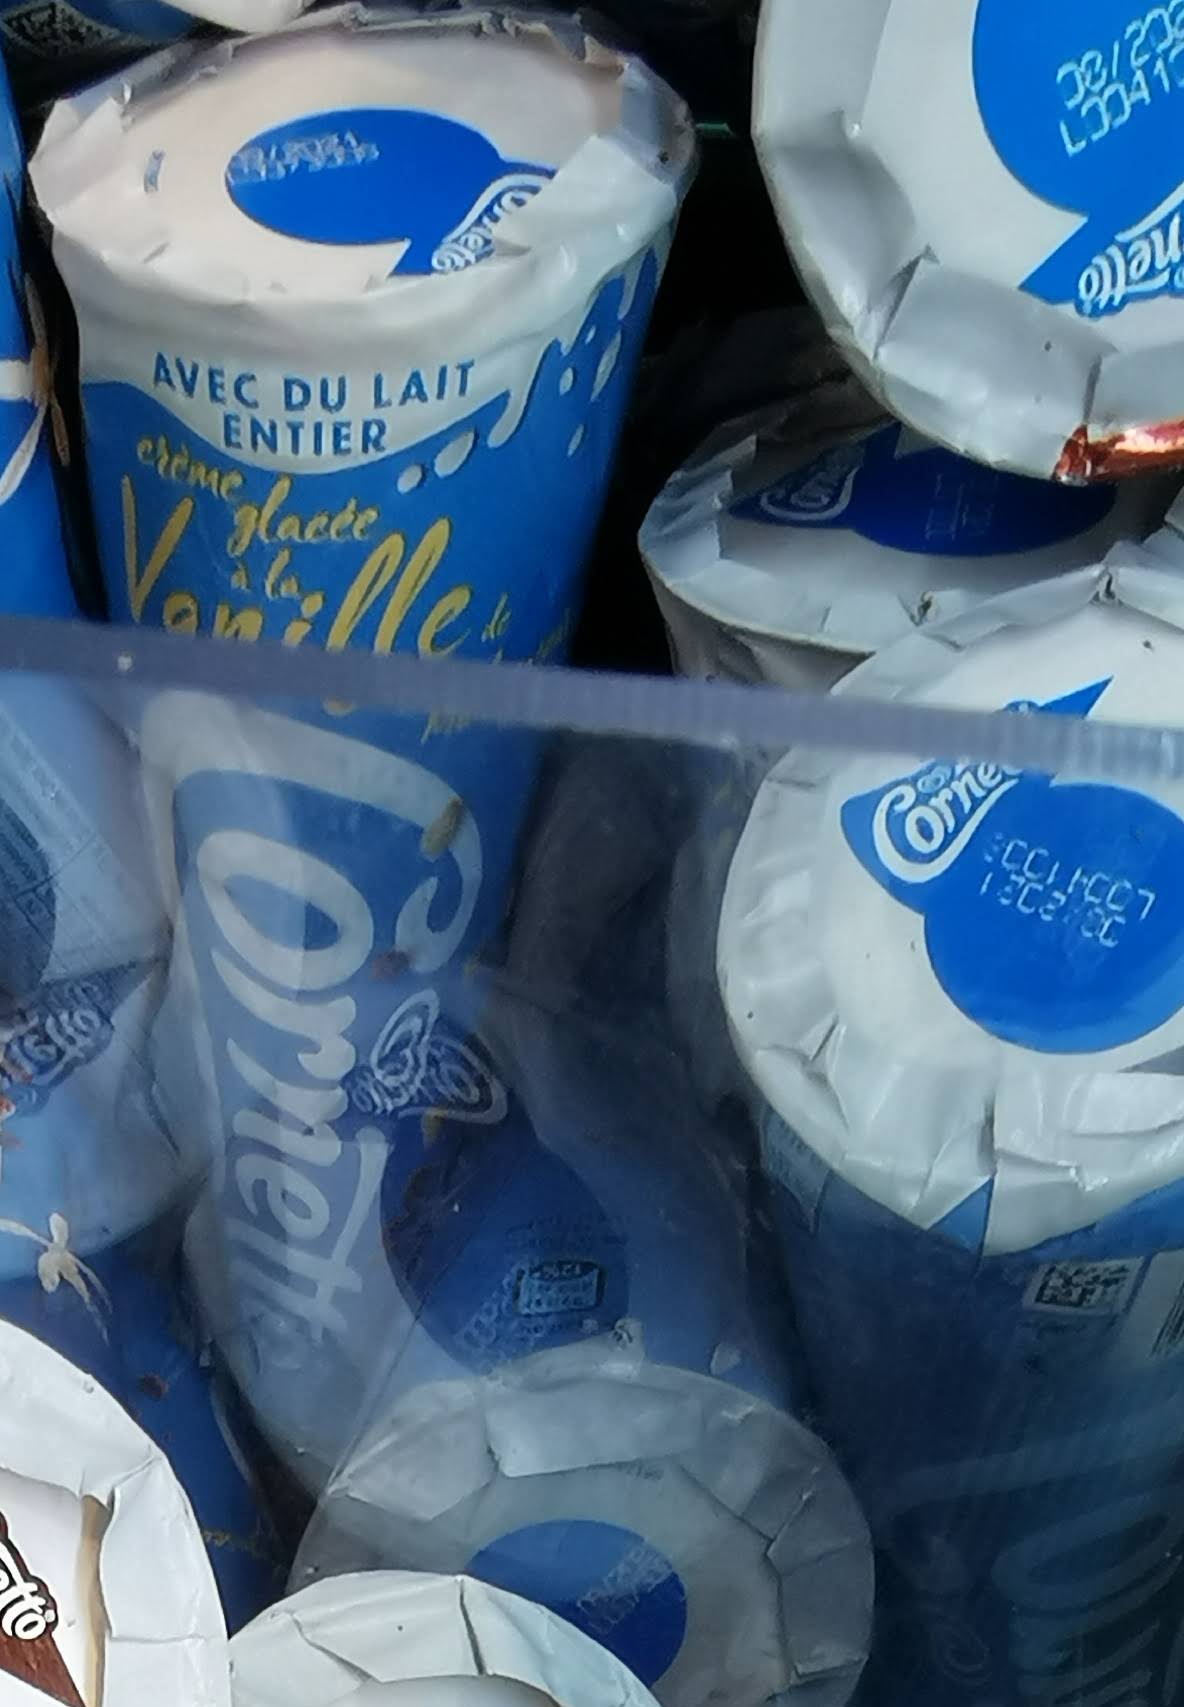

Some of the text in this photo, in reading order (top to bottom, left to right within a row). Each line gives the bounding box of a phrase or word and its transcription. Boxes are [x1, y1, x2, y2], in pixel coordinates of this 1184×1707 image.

[153, 351, 476, 413] AVEC DU LAIT
[223, 413, 388, 454] ENTIER
